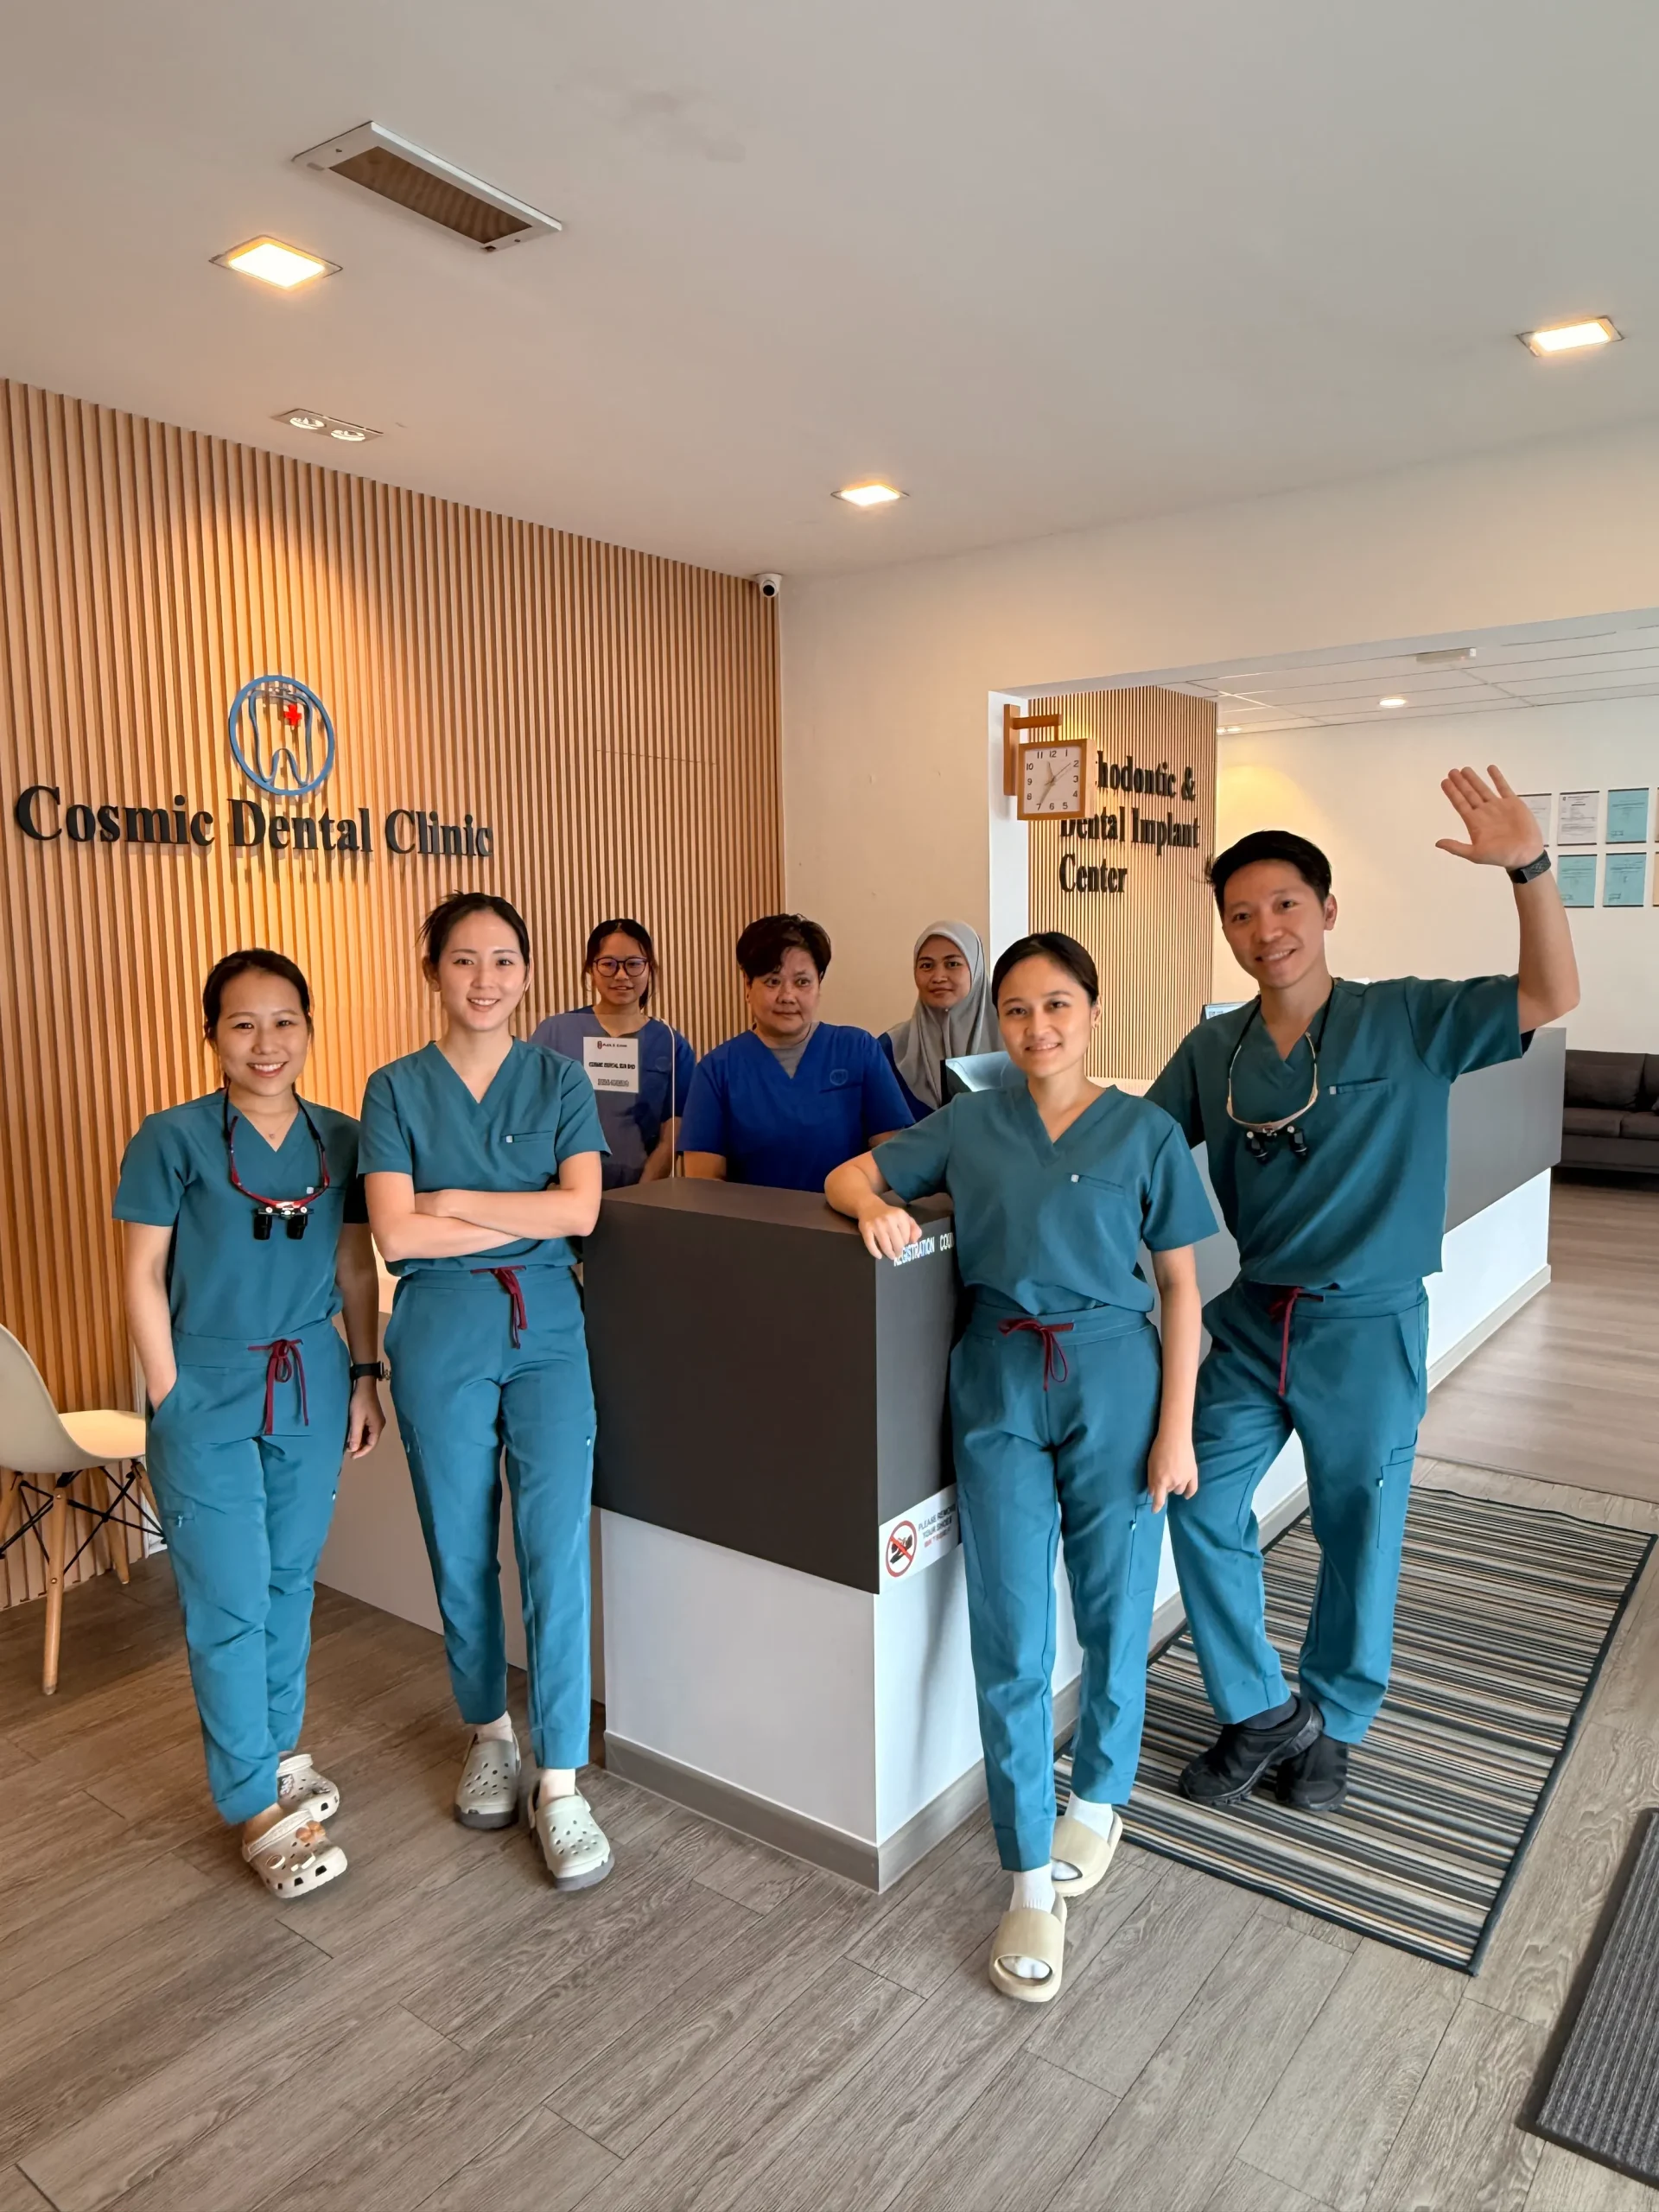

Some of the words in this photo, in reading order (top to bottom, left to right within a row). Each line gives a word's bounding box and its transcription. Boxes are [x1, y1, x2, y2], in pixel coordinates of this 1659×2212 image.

[1037, 751, 1043, 760] 11
[1096, 750, 1176, 798] hodontic
[1181, 766, 1197, 802] &
[16, 785, 214, 847] Cosmic
[227, 798, 372, 853] Dental
[385, 809, 493, 857] Clinic
[1131, 807, 1201, 856] Implant
[1059, 852, 1128, 893] Center
[918, 1515, 937, 1531] PLEASE
